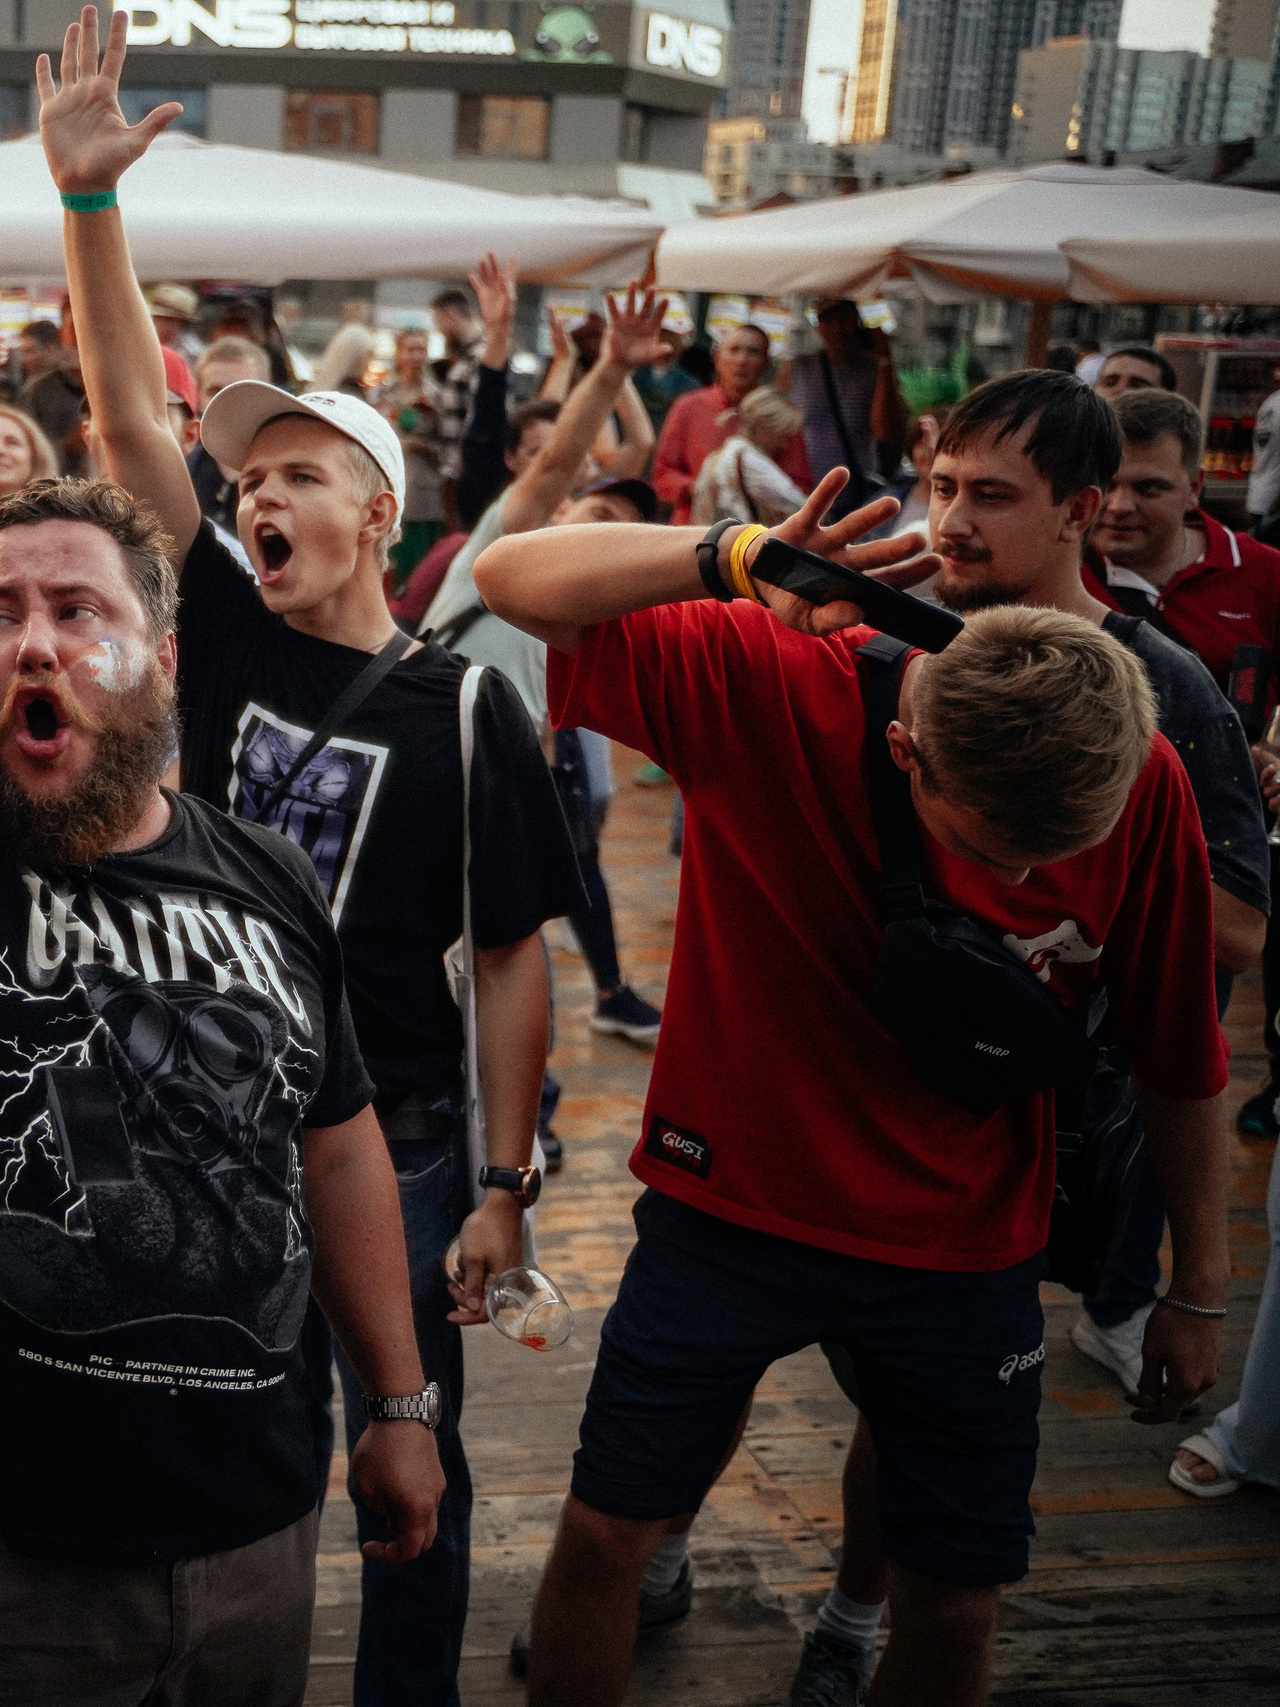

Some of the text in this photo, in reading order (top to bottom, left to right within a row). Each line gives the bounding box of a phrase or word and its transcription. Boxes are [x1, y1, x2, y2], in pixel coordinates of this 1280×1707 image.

[112, 0, 293, 49] DNS
[645, 11, 723, 78] DNS
[974, 1041, 1010, 1057] WARP
[44, 1357, 53, 1366] S
[55, 1360, 83, 1373] SAN
[85, 1366, 141, 1383] VICENTE
[142, 1374, 175, 1386] BLVD,
[178, 1378, 203, 1388] LOS
[203, 1381, 255, 1391] ANGELES,
[256, 1380, 268, 1389] CA
[89, 1354, 256, 1378] PIC PARTNER IN CRIME INC.
